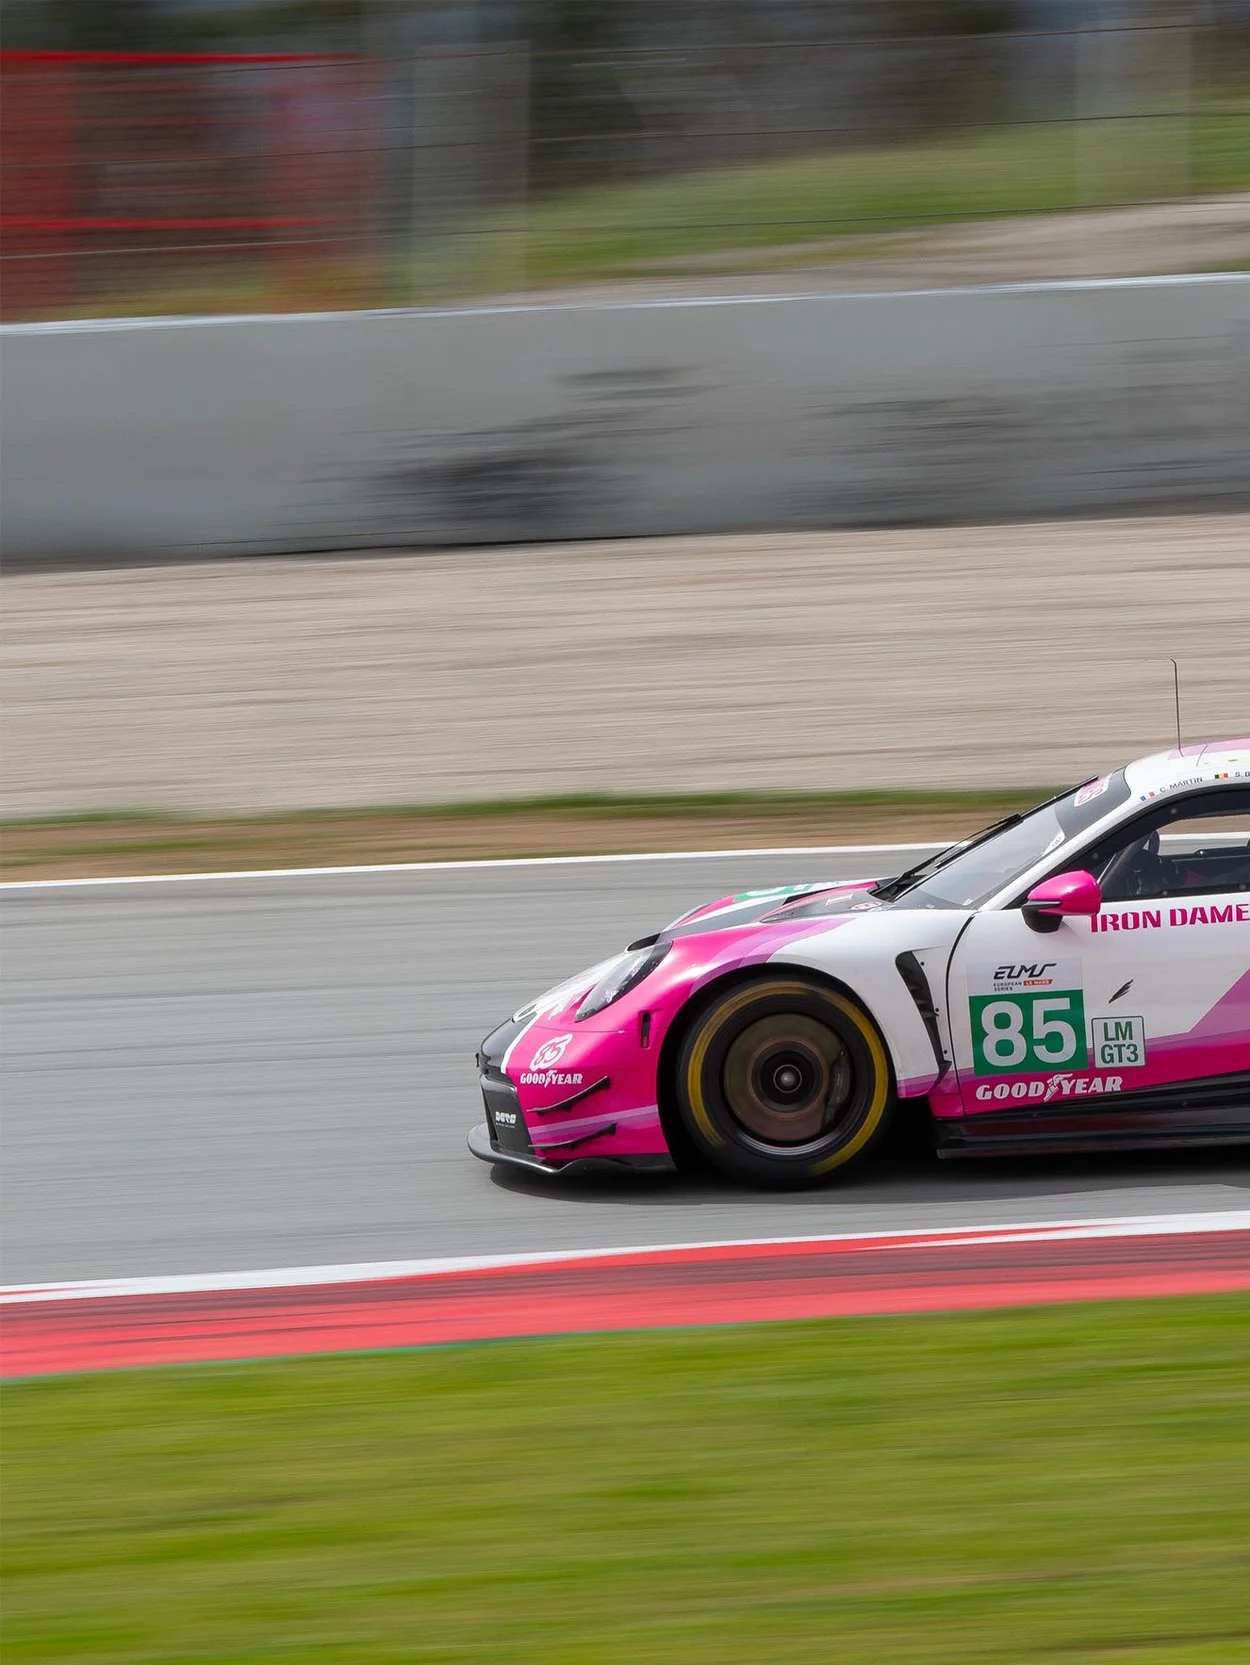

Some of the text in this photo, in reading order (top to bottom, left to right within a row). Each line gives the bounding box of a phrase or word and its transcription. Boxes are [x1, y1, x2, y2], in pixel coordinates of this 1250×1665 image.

[1169, 776, 1203, 790] MARTIN
[1090, 909, 1161, 933] IRON
[980, 997, 1077, 1067] 85
[1103, 1021, 1133, 1042] LM
[1100, 1043, 1139, 1064] GT3
[520, 1070, 583, 1087] GOODYEAR
[976, 1073, 1123, 1101] GOODYEAR
